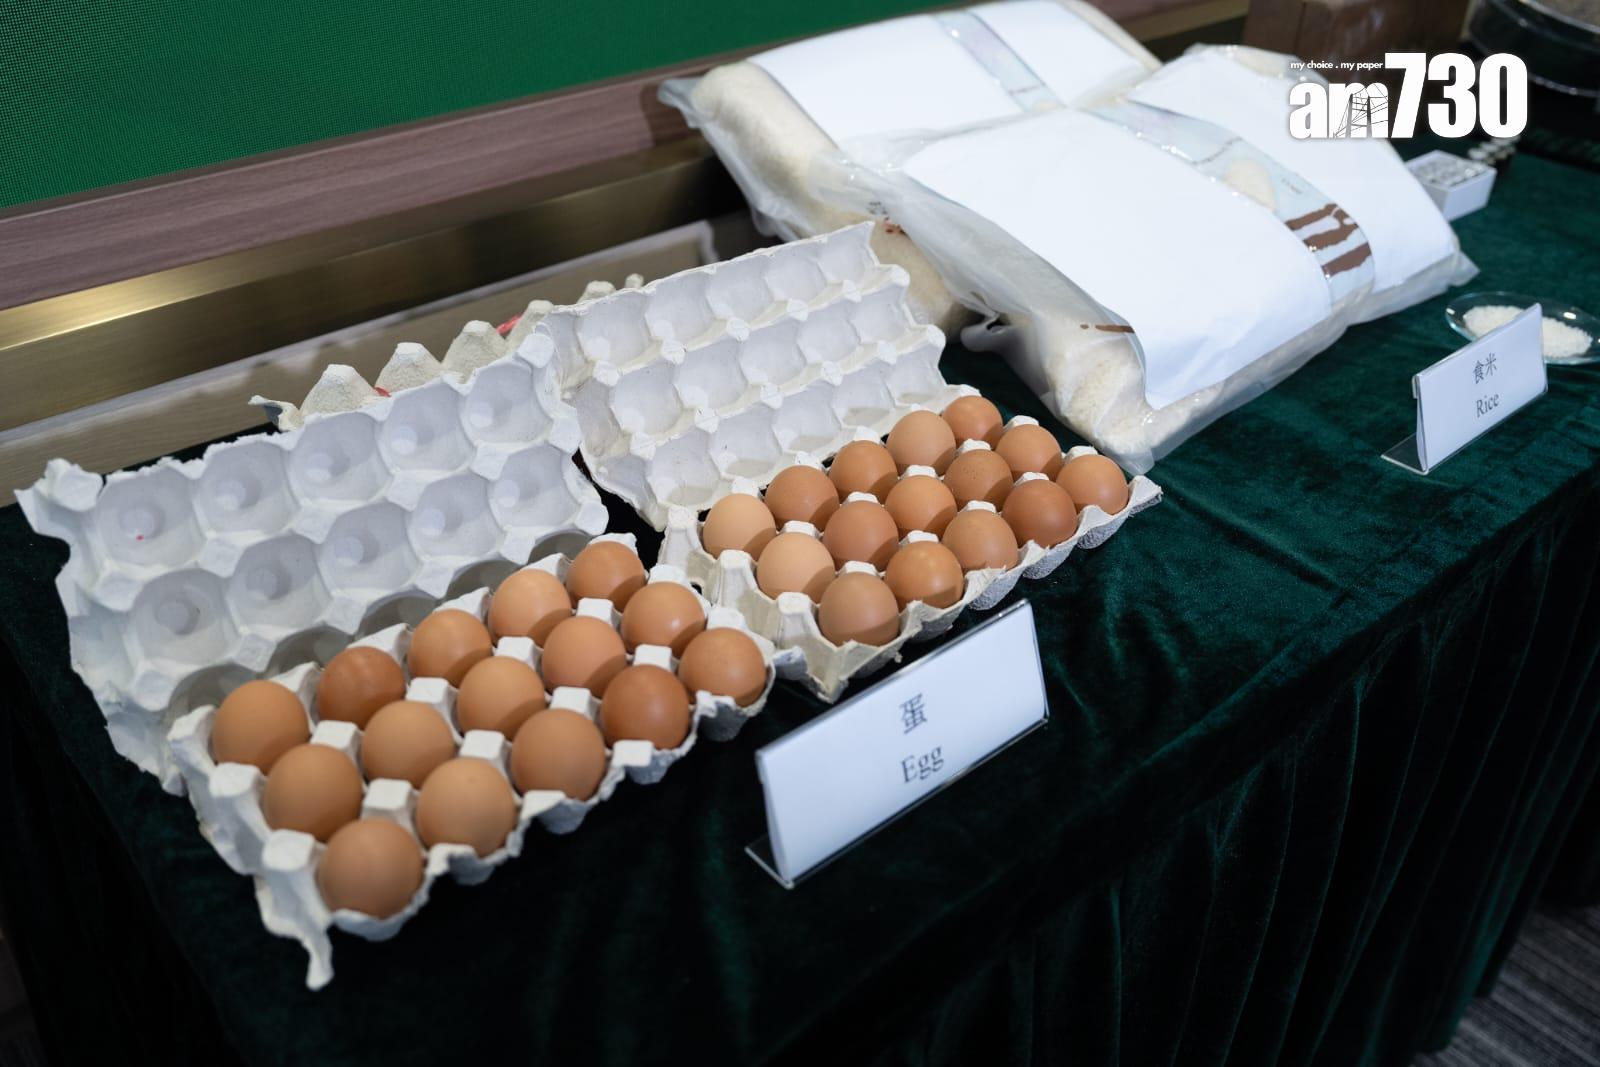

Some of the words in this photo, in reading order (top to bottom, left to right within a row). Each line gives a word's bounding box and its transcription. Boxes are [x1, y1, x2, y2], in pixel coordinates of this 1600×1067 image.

[1473, 352, 1498, 385] 食米
[1476, 393, 1500, 418] Rice
[900, 693, 928, 735] 蛋
[901, 746, 944, 783] Egg
